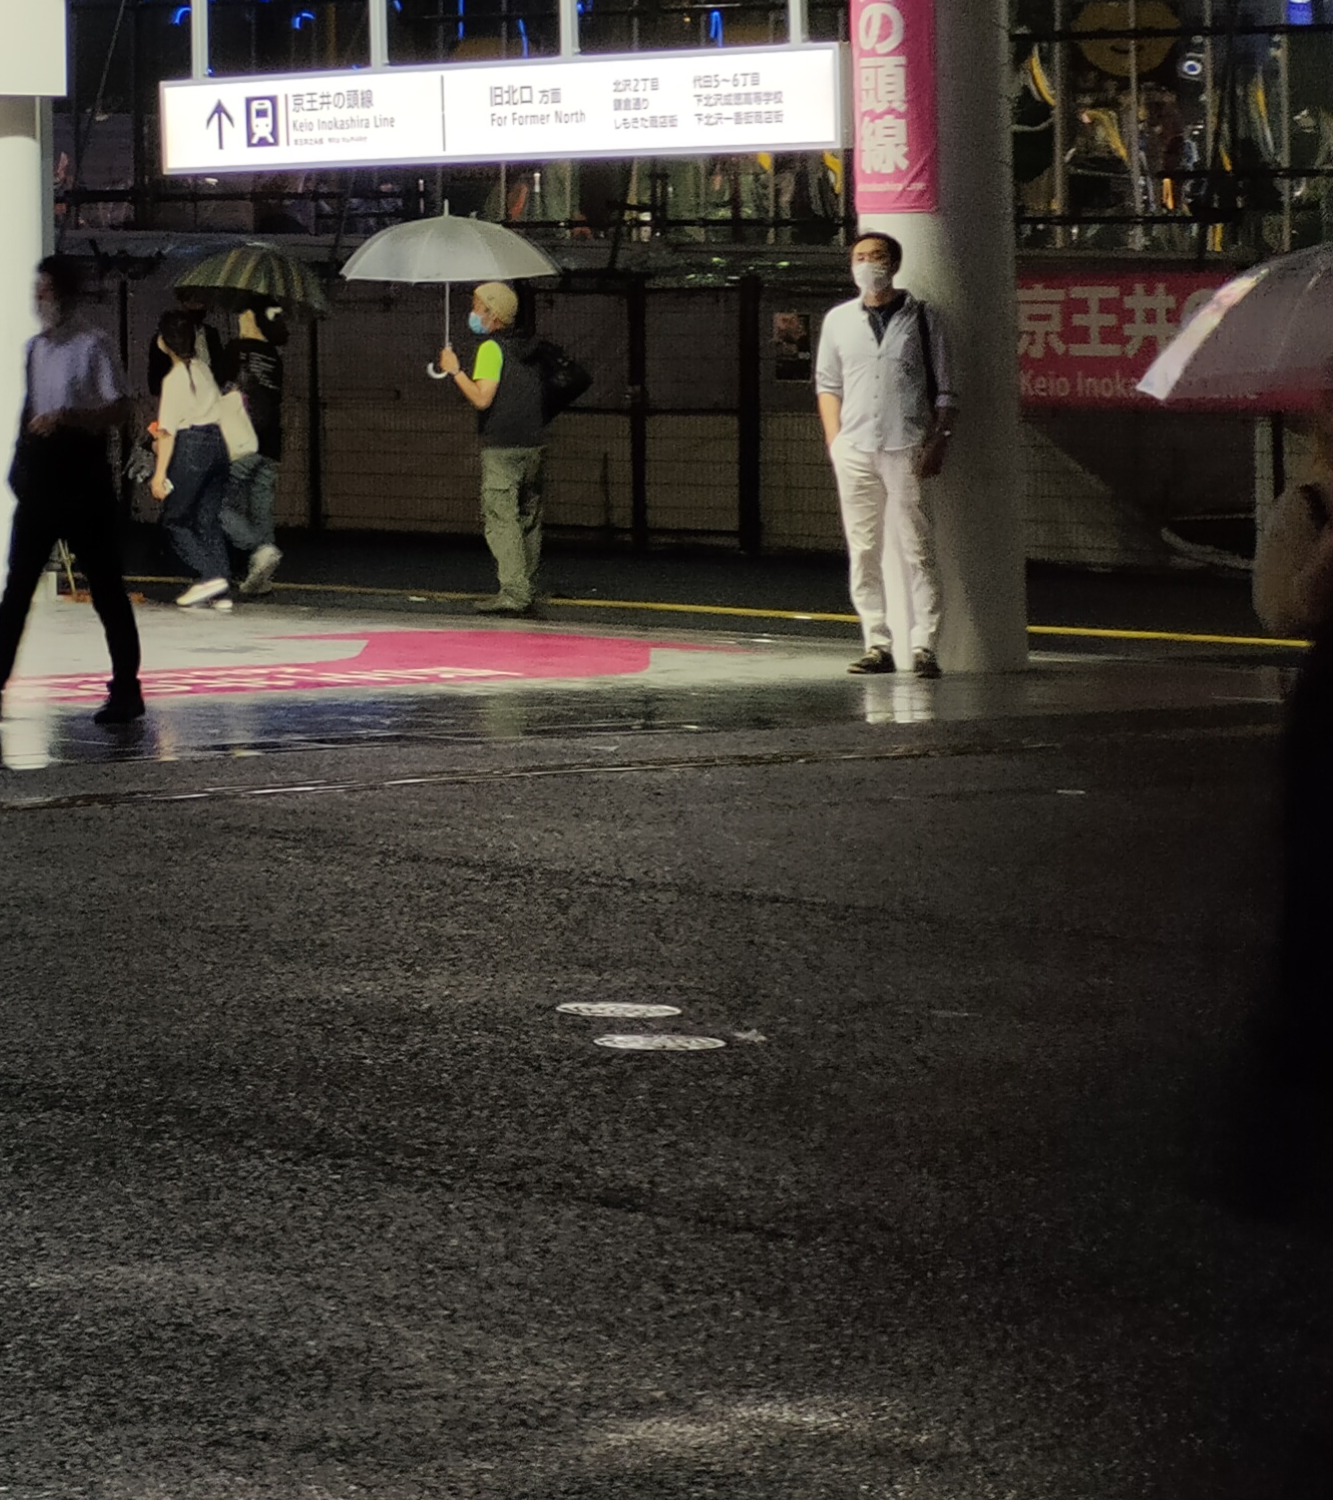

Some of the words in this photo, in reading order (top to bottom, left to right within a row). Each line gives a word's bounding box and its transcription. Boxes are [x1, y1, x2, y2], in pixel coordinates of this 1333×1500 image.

[292, 89, 374, 113] 京王井の頭線
[489, 86, 534, 107] 旧北口
[538, 88, 561, 105] 方面
[292, 117, 314, 132] Keio
[317, 115, 370, 131] Inokashira
[374, 114, 395, 129] Line
[491, 112, 509, 127] For
[511, 111, 551, 127] Former
[554, 109, 587, 125] North
[1017, 284, 1217, 358] 京王井
[1019, 371, 1070, 397] Keio
